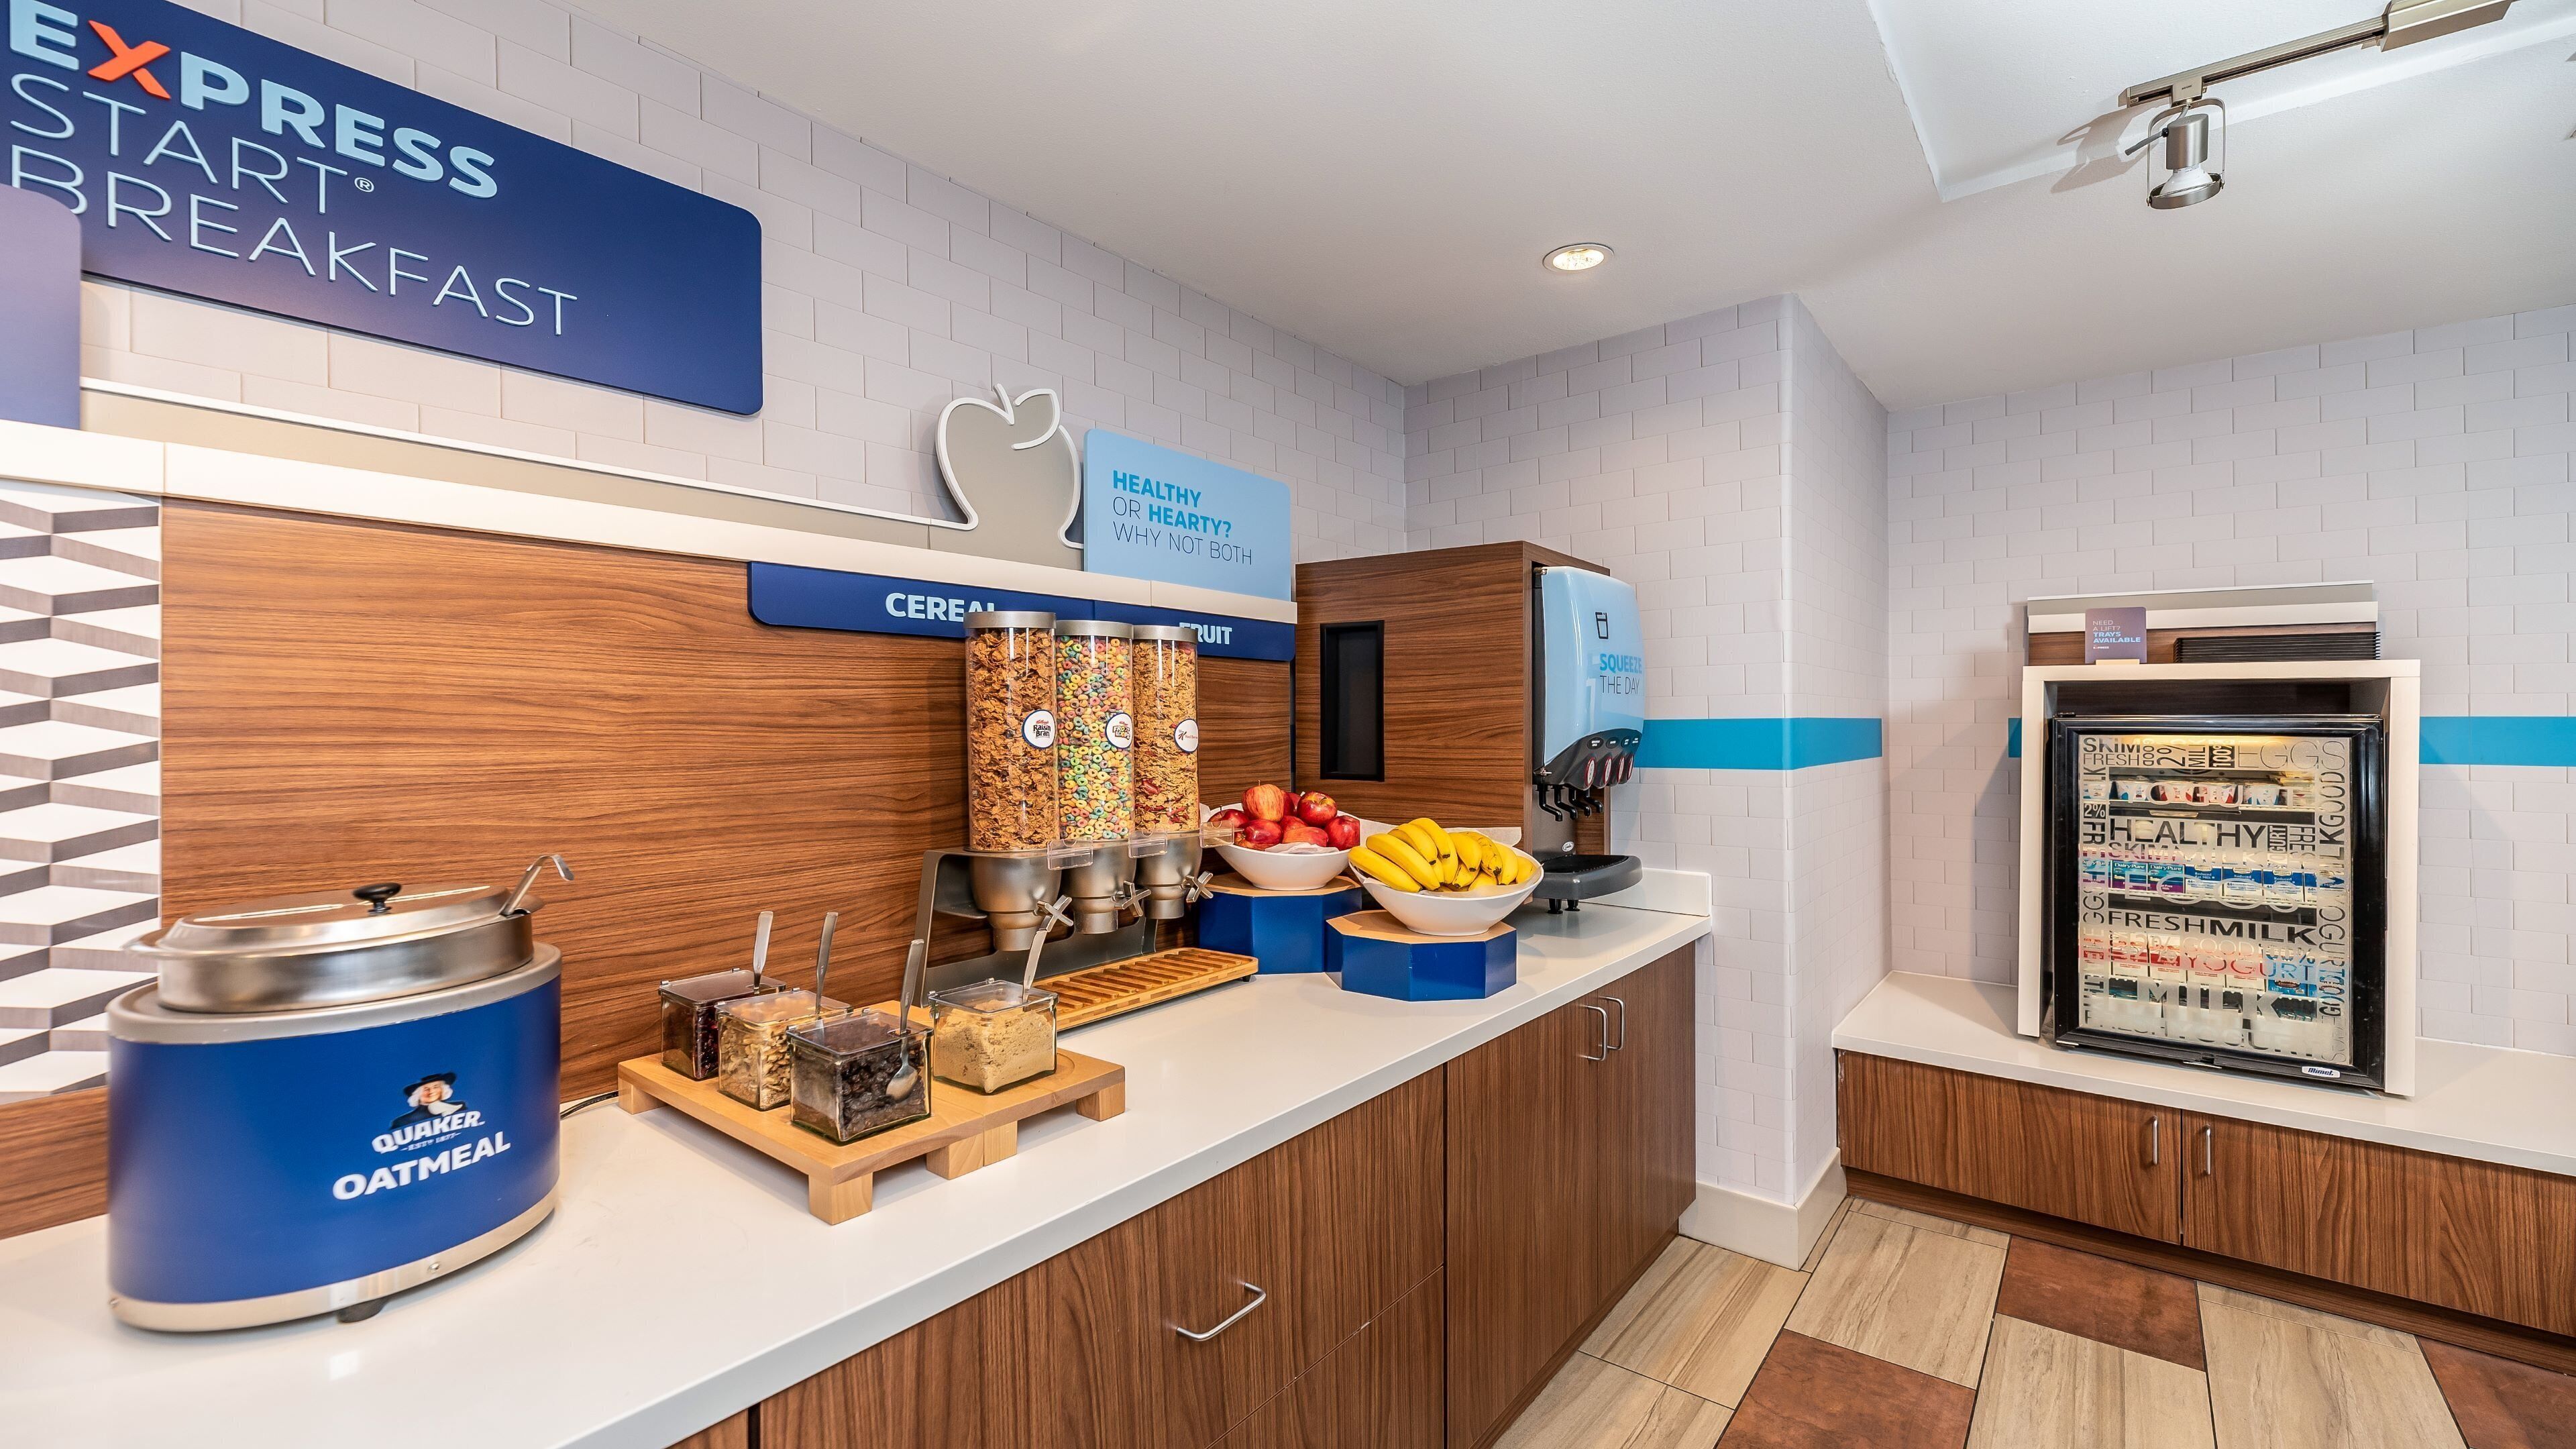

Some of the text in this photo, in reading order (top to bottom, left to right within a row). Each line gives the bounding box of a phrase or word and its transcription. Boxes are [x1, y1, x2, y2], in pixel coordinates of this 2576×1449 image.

[9, 0, 498, 199] EXPRESS
[11, 144, 578, 336] BREAKFAST
[1113, 470, 1201, 508] HEALTHY
[1113, 496, 1232, 538] OR HEARTY?
[1113, 521, 1252, 565] WHY NOT BOTH
[1599, 653, 1642, 674] SQUEEZE
[1599, 675, 1640, 695] THE DAY
[2083, 753, 2140, 766] FRESH
[2084, 804, 2106, 818] 2%
[2110, 818, 2267, 849] HEALTHY
[2184, 951, 2314, 981] YOGURT
[372, 1110, 482, 1154] QUAKER
[332, 1131, 511, 1201] OATMEAL
